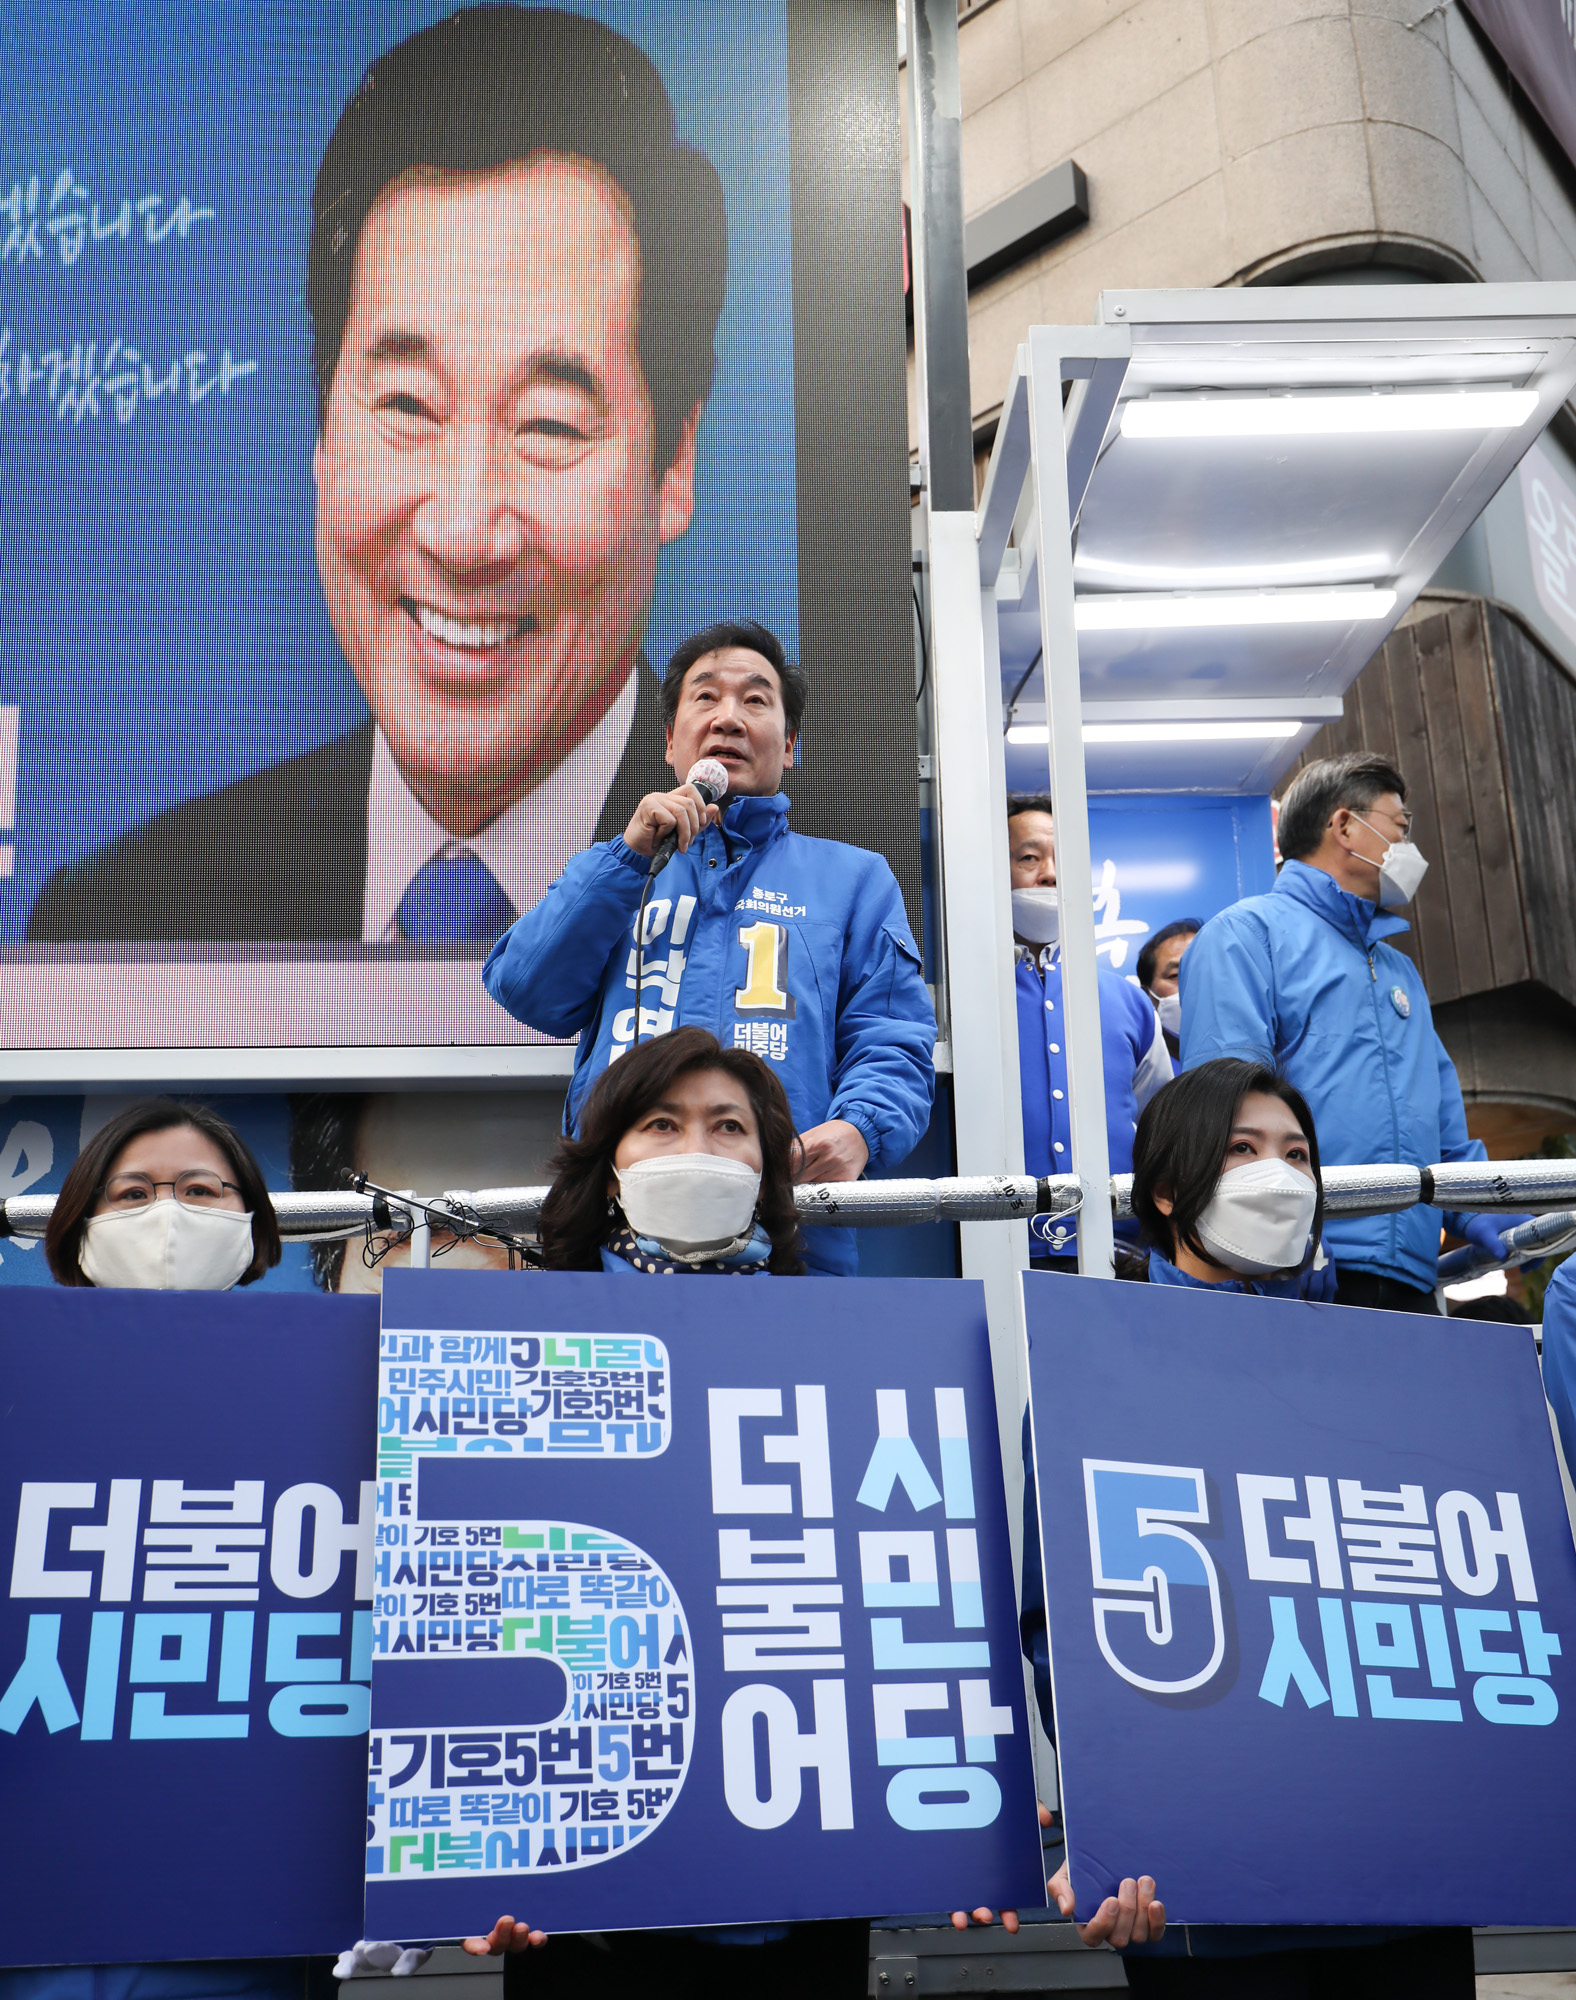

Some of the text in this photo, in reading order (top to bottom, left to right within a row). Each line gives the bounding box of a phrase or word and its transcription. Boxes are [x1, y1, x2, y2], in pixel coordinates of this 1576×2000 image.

[734, 898, 807, 918] 국회의원선거
[752, 886, 789, 905] 종로구
[734, 919, 788, 1011] 1
[734, 1022, 788, 1042] 더불어
[440, 1336, 507, 1365] 함께
[388, 1368, 512, 1397] 민주시민!
[530, 1388, 645, 1420] 기호5번
[9, 1478, 377, 1602] 더불어
[1235, 1472, 1540, 1603] 더불어
[502, 1575, 571, 1610] 따로
[1082, 1457, 1226, 1695] 5
[413, 1593, 460, 1616] 기호
[707, 1384, 855, 1831] 더불어
[855, 1386, 1015, 1831] 시민당
[0, 1610, 374, 1741] 시민당
[1257, 1595, 1563, 1727] 시민당
[596, 1671, 631, 1690] 기호
[634, 1671, 662, 1690] 5번
[389, 1795, 452, 1828] 따로
[460, 1791, 552, 1826] 똑같이
[559, 1789, 620, 1822] 기호
